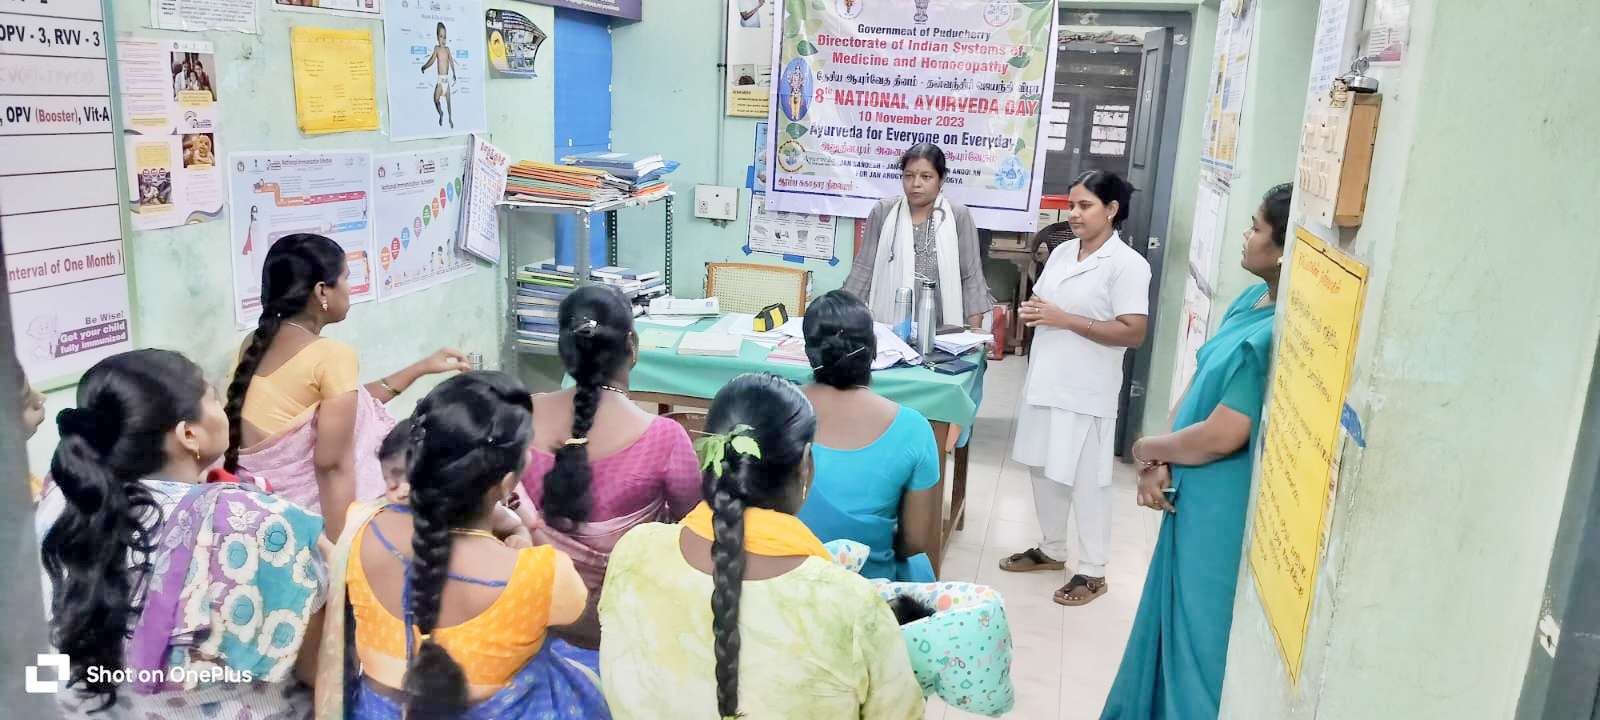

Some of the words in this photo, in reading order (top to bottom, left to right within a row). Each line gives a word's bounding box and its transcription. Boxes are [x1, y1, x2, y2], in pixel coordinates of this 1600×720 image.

[0, 24, 25, 42] OPV
[38, 27, 51, 47] 3,
[54, 28, 81, 45] RVV
[93, 31, 100, 47] 3
[857, 23, 917, 37] Government
[920, 27, 930, 37] of
[933, 28, 991, 41] Puducherry
[817, 34, 887, 50] Directorate
[891, 38, 904, 51] of
[908, 39, 949, 53] Indian
[953, 41, 1006, 56] Systems
[832, 51, 889, 67] Medicine
[893, 56, 917, 68] and
[921, 56, 1009, 75] Homoeopathy
[846, 73, 891, 86] ஆயுர்வேத
[893, 75, 918, 88] தினம்
[834, 89, 909, 110] NATIONAL
[914, 93, 999, 115] AYURVEDA
[1004, 99, 1038, 117] DAY
[6, 105, 31, 123] OPV
[859, 111, 872, 122] 10
[876, 111, 932, 126] November
[935, 115, 965, 128] 2023
[810, 125, 863, 139] Ayurveda
[866, 126, 883, 140] for
[886, 128, 940, 146] Everyone
[943, 133, 958, 145] on
[962, 132, 1015, 150] Everyday
[869, 171, 881, 179] JAN
[883, 172, 903, 180] AROGY
[50, 259, 60, 275] of
[64, 258, 84, 272] One
[86, 251, 116, 269] Month
[85, 316, 97, 325] Be
[100, 310, 124, 322] Wise!
[60, 343, 79, 353] fully
[82, 332, 126, 348] immunized
[61, 332, 78, 343] Get
[80, 328, 101, 340] your
[103, 321, 125, 333] child
